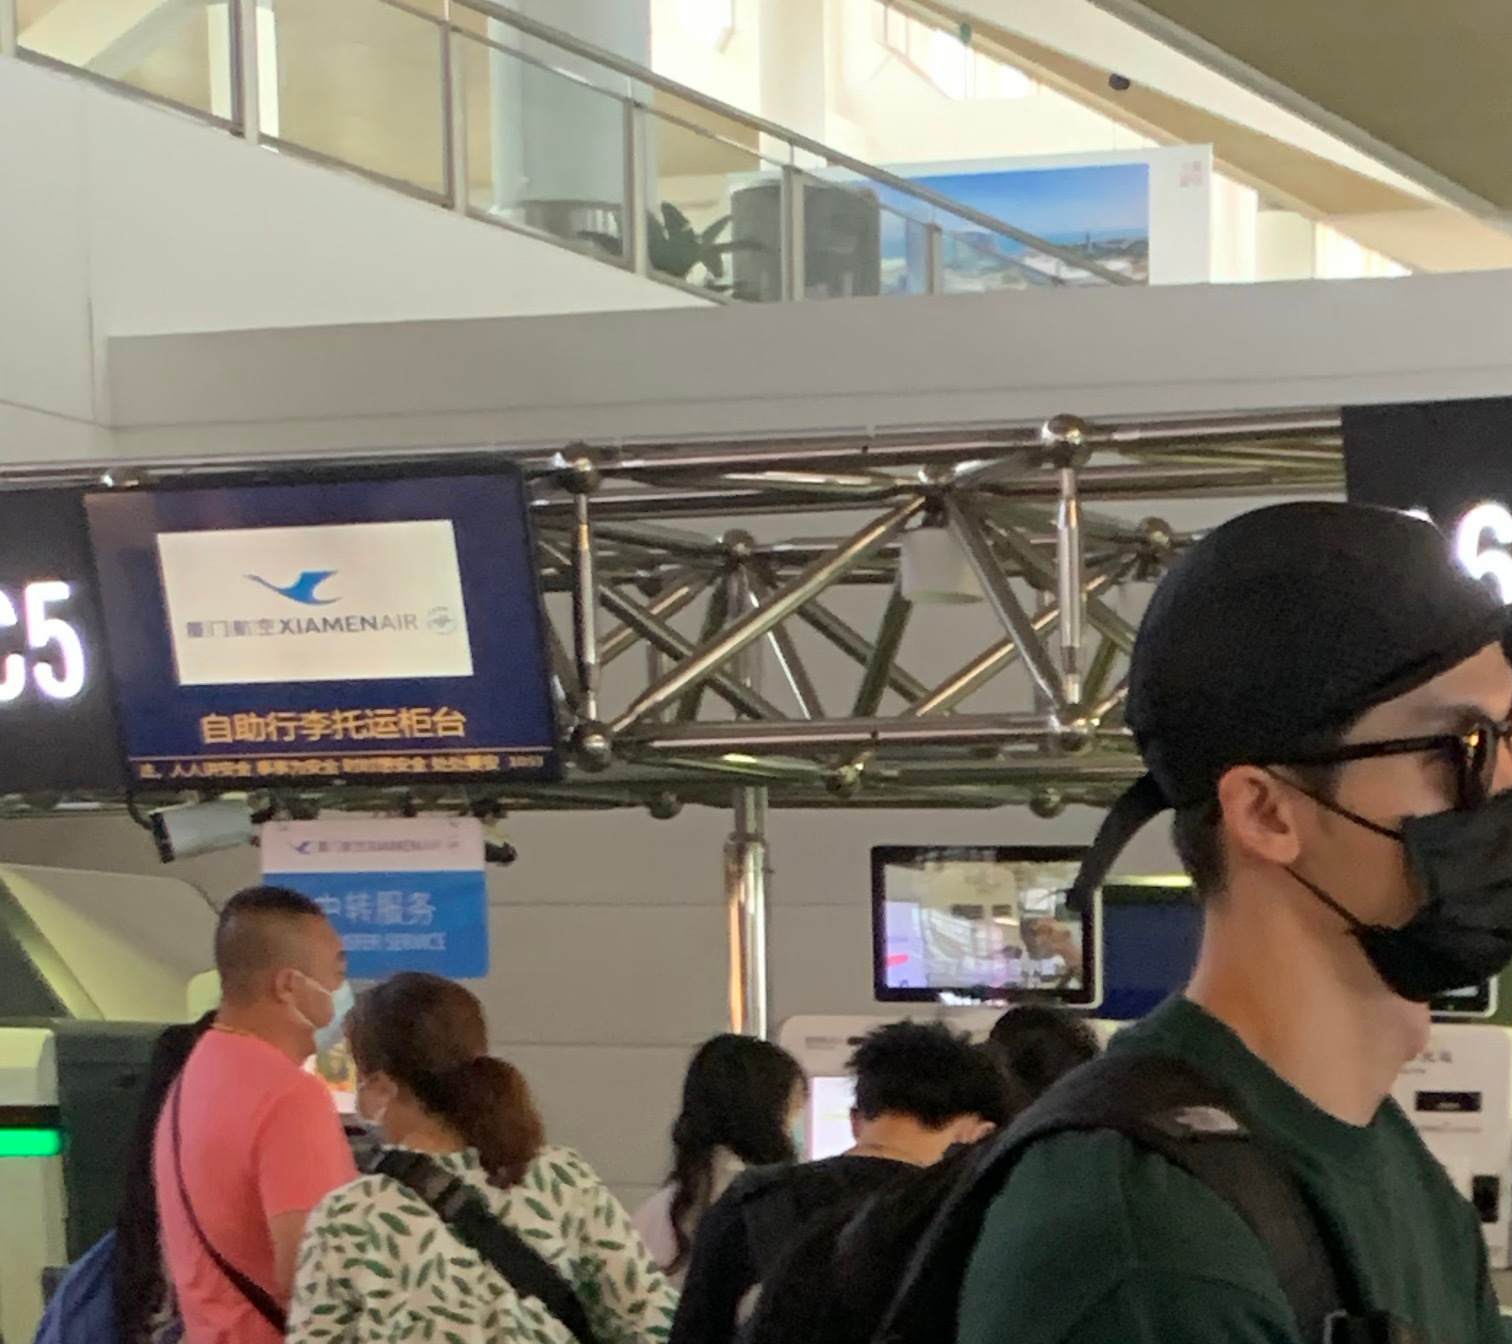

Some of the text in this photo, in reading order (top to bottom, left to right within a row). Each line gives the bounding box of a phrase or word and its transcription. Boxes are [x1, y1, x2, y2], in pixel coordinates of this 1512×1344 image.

[279, 613, 419, 634] XIAMENAIR
[201, 706, 468, 744] 自助行李托运柜台
